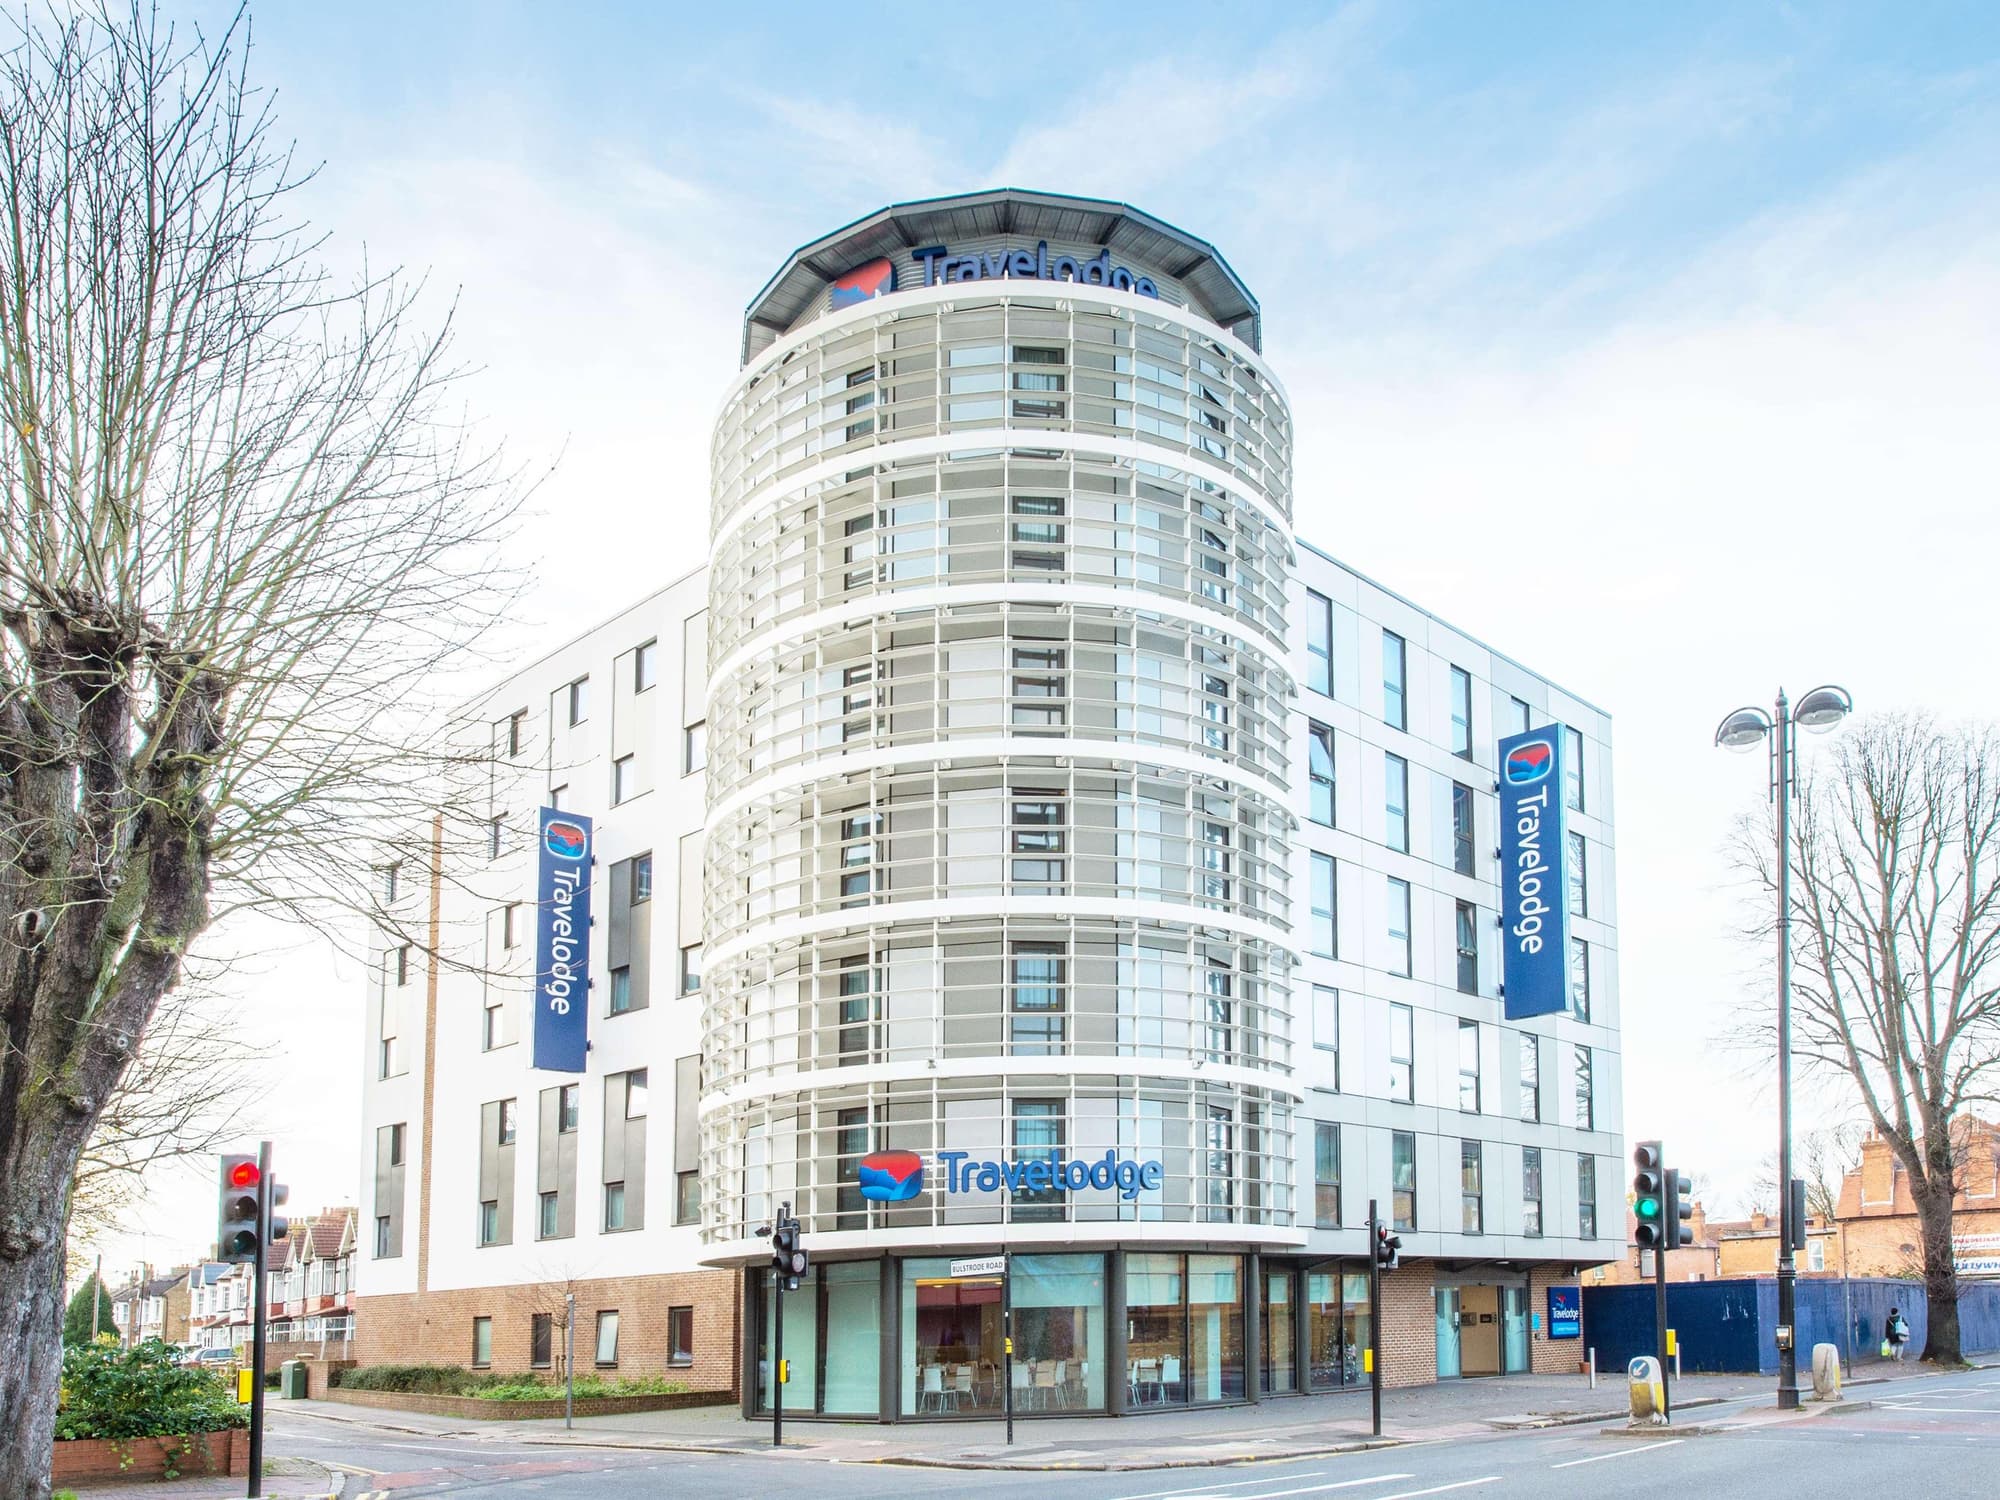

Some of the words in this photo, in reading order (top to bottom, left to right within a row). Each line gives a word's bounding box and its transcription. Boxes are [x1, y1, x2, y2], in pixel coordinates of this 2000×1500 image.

[1513, 784, 1550, 954] Travelodge
[544, 866, 581, 1016] Travelodge
[938, 1149, 1164, 1200] Travelodge
[952, 1263, 985, 1273] BULSTRODE
[985, 1260, 1004, 1270] ROAD
[1552, 1307, 1579, 1320] Travelodge
